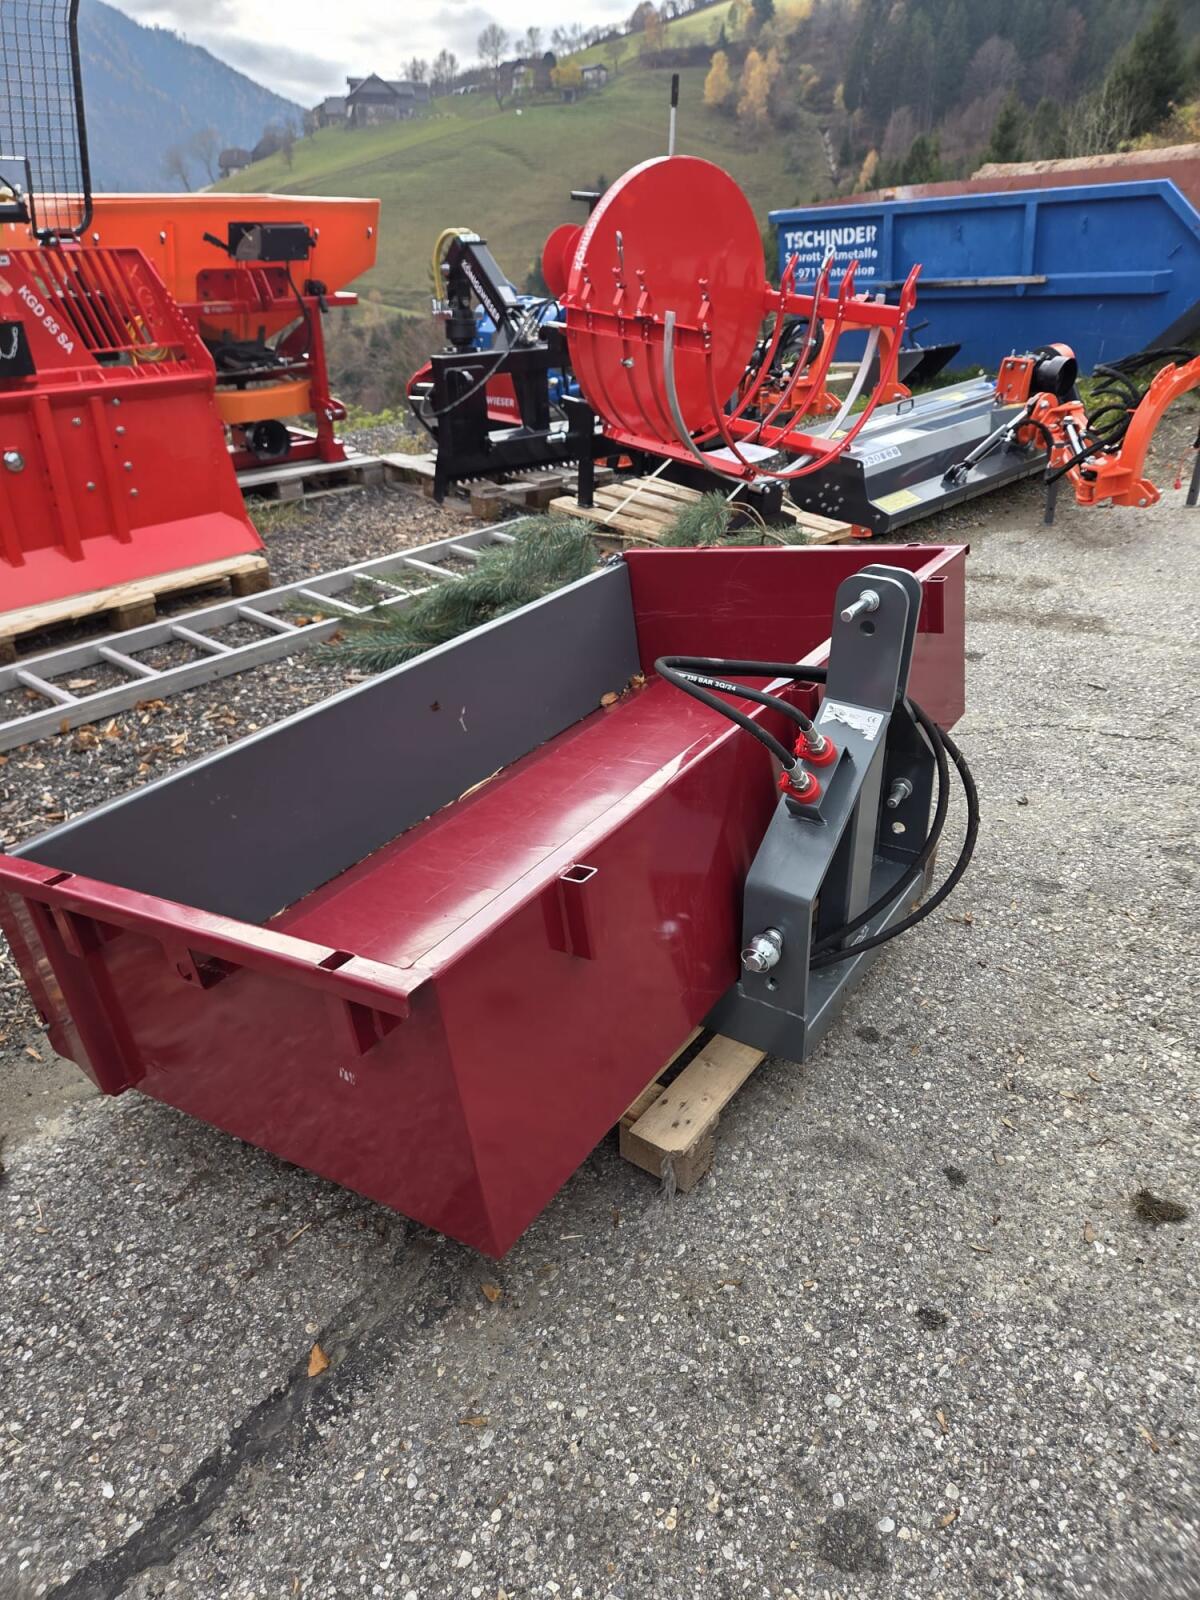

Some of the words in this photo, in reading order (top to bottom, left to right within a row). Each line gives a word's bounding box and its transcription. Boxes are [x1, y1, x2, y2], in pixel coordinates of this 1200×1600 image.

[784, 225, 877, 249] TSCHINDER
[18, 285, 45, 317] KGD
[43, 316, 60, 335] 55
[56, 332, 74, 354] SA
[698, 676, 713, 685] BAR
